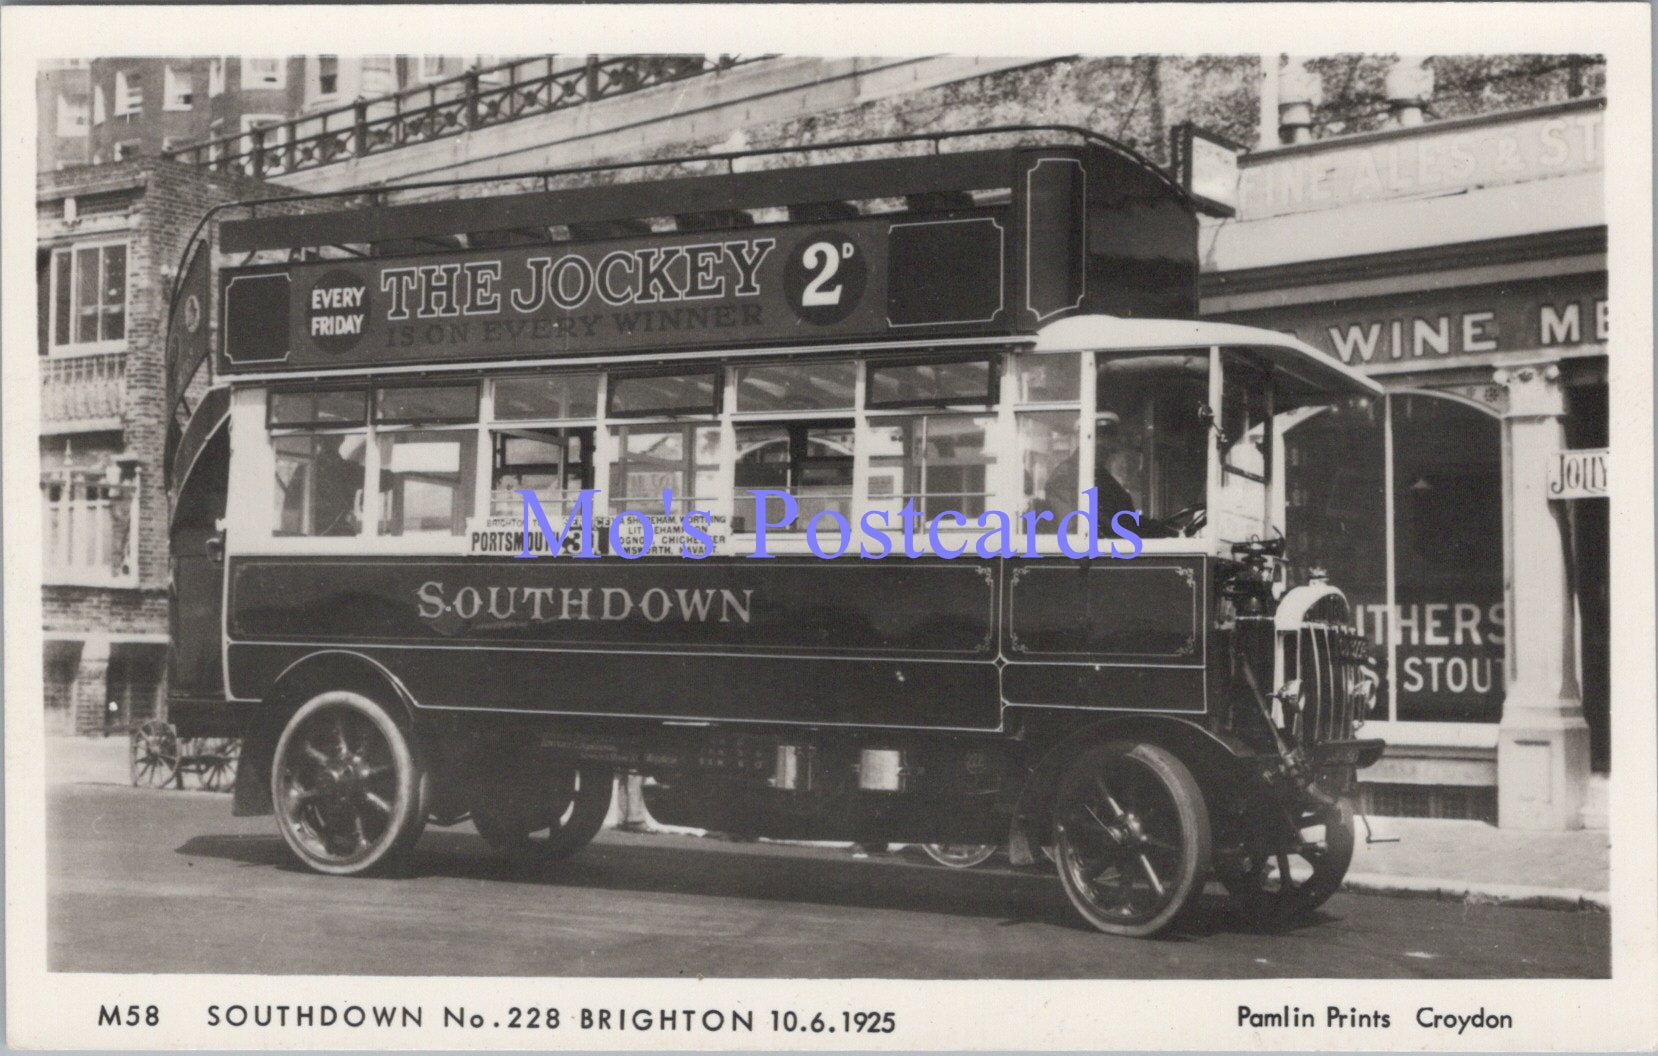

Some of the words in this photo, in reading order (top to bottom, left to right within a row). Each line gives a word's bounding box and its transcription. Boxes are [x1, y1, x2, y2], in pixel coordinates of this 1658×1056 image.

[1353, 144, 1475, 194] ALES
[312, 286, 366, 309] EVERY
[380, 259, 501, 320] THE
[511, 238, 776, 313] JOCKEY
[311, 313, 365, 336] FRIDAY
[386, 326, 415, 347] IS
[425, 324, 468, 345] ON
[484, 315, 602, 343] EVERY
[611, 303, 763, 335] WINNER
[1328, 312, 1497, 363] WINE
[486, 518, 528, 527] BRIGHTO
[416, 581, 755, 623] SOUTHDOWN
[1403, 656, 1504, 694] STOU
